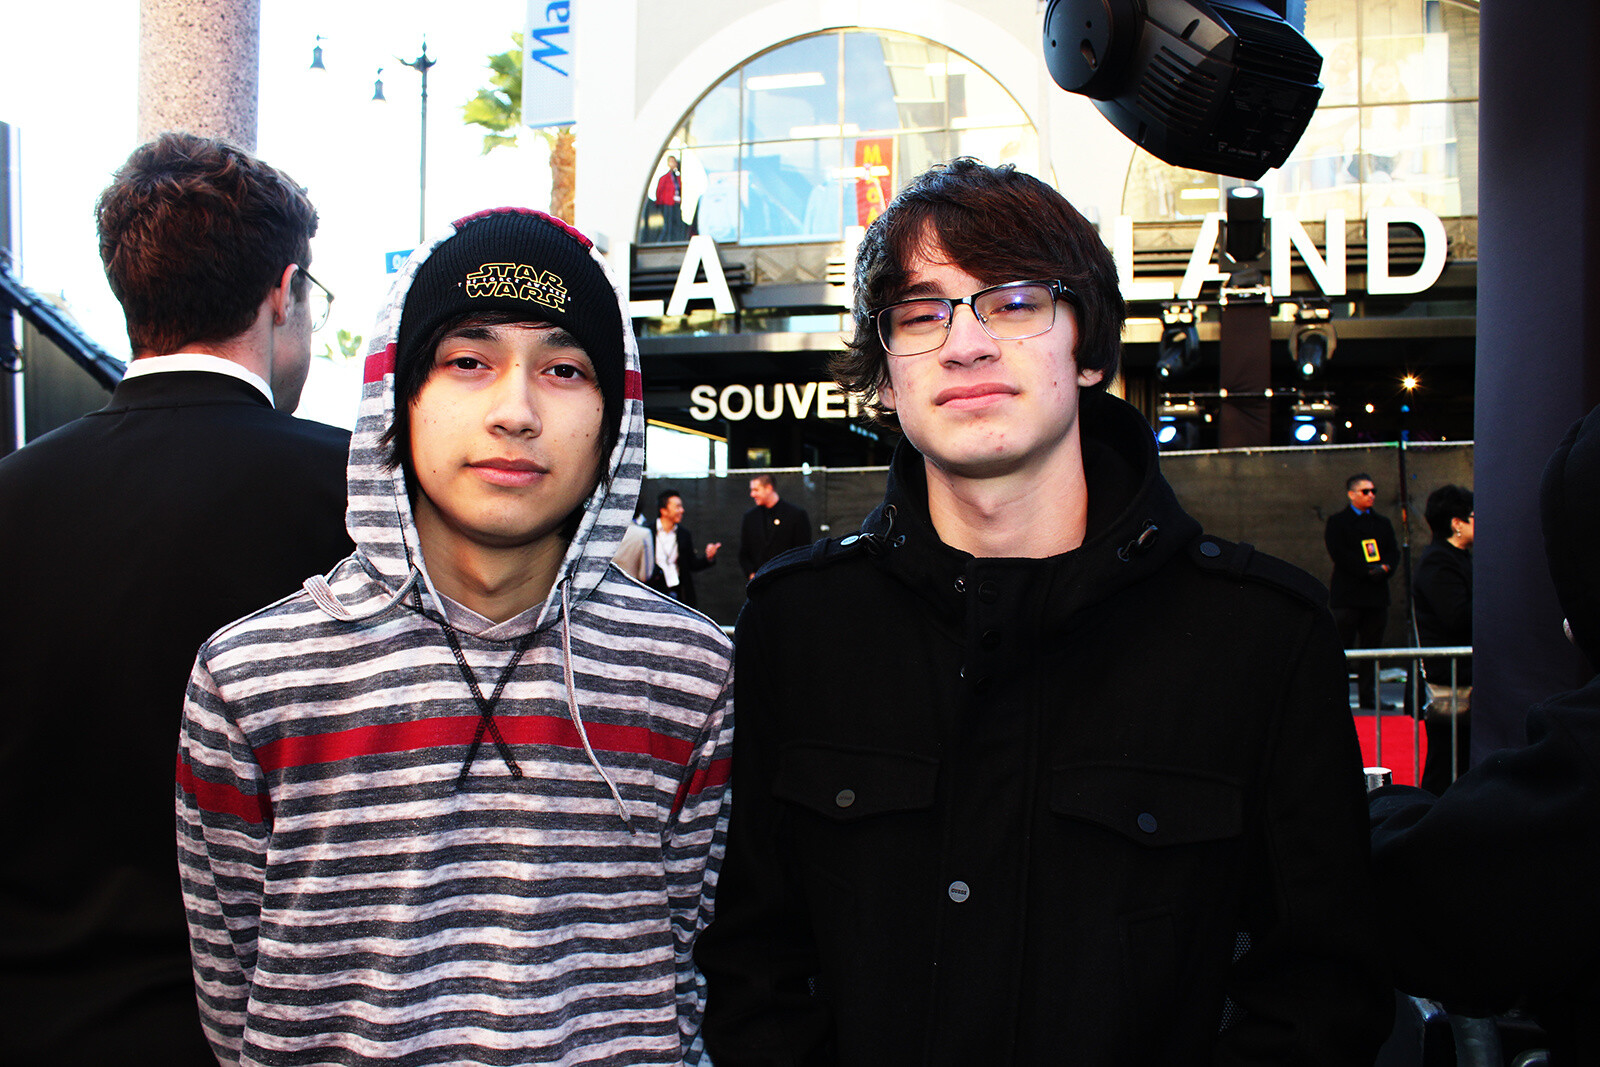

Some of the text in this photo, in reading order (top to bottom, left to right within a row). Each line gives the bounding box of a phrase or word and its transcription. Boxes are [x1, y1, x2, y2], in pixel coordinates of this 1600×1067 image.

[531, 0, 570, 77] Ma
[466, 262, 567, 294] STAR
[466, 281, 565, 309] WARS
[613, 235, 736, 318] LA
